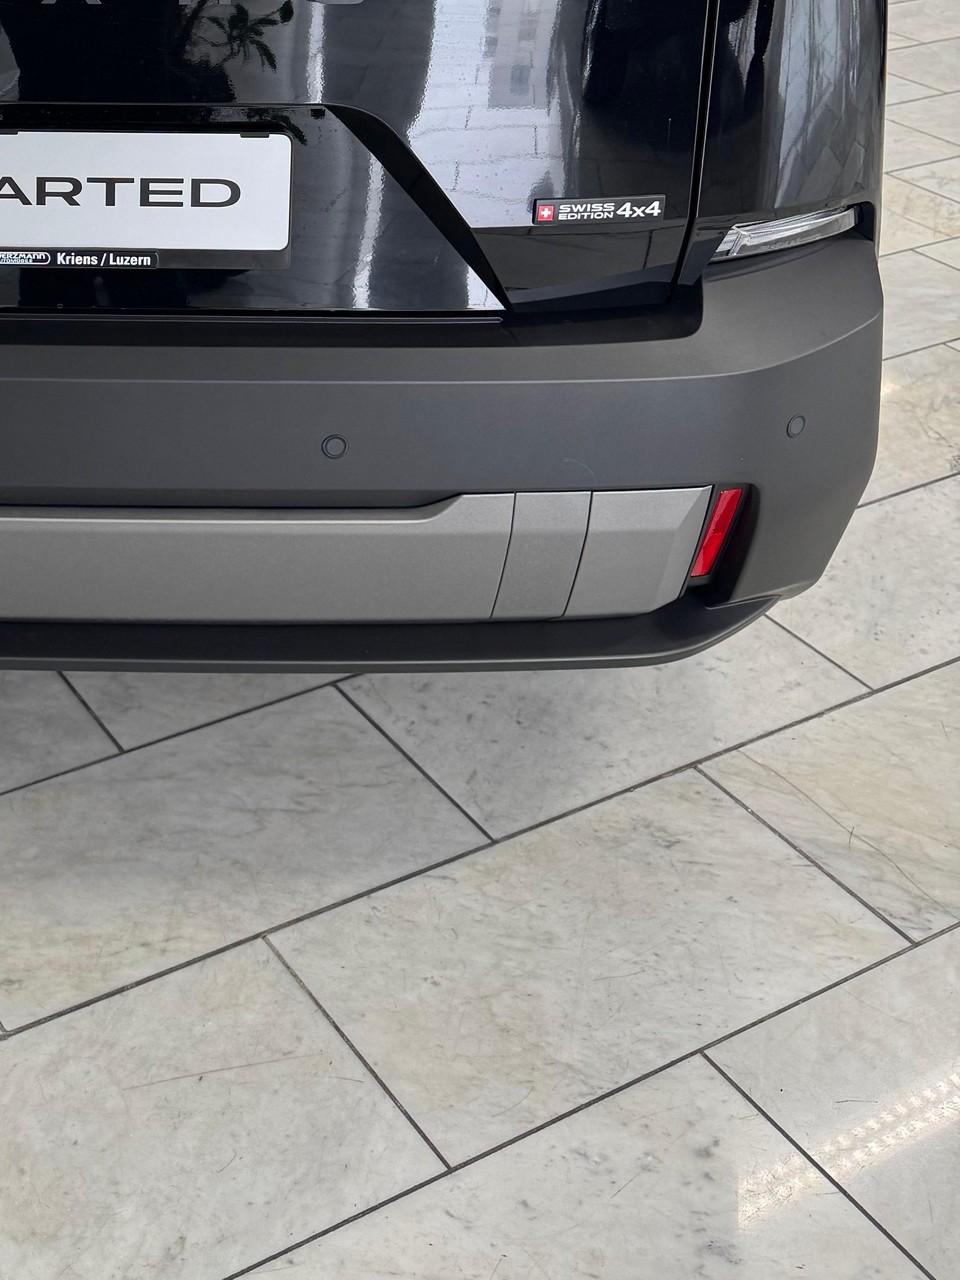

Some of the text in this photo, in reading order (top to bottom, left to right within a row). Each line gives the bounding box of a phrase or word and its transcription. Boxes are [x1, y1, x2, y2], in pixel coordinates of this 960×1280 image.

[559, 202, 615, 213] SWISS
[616, 200, 661, 218] 4x4
[558, 211, 614, 220] EDITION
[56, 252, 99, 266] Kriens
[109, 252, 151, 266] Luzern
